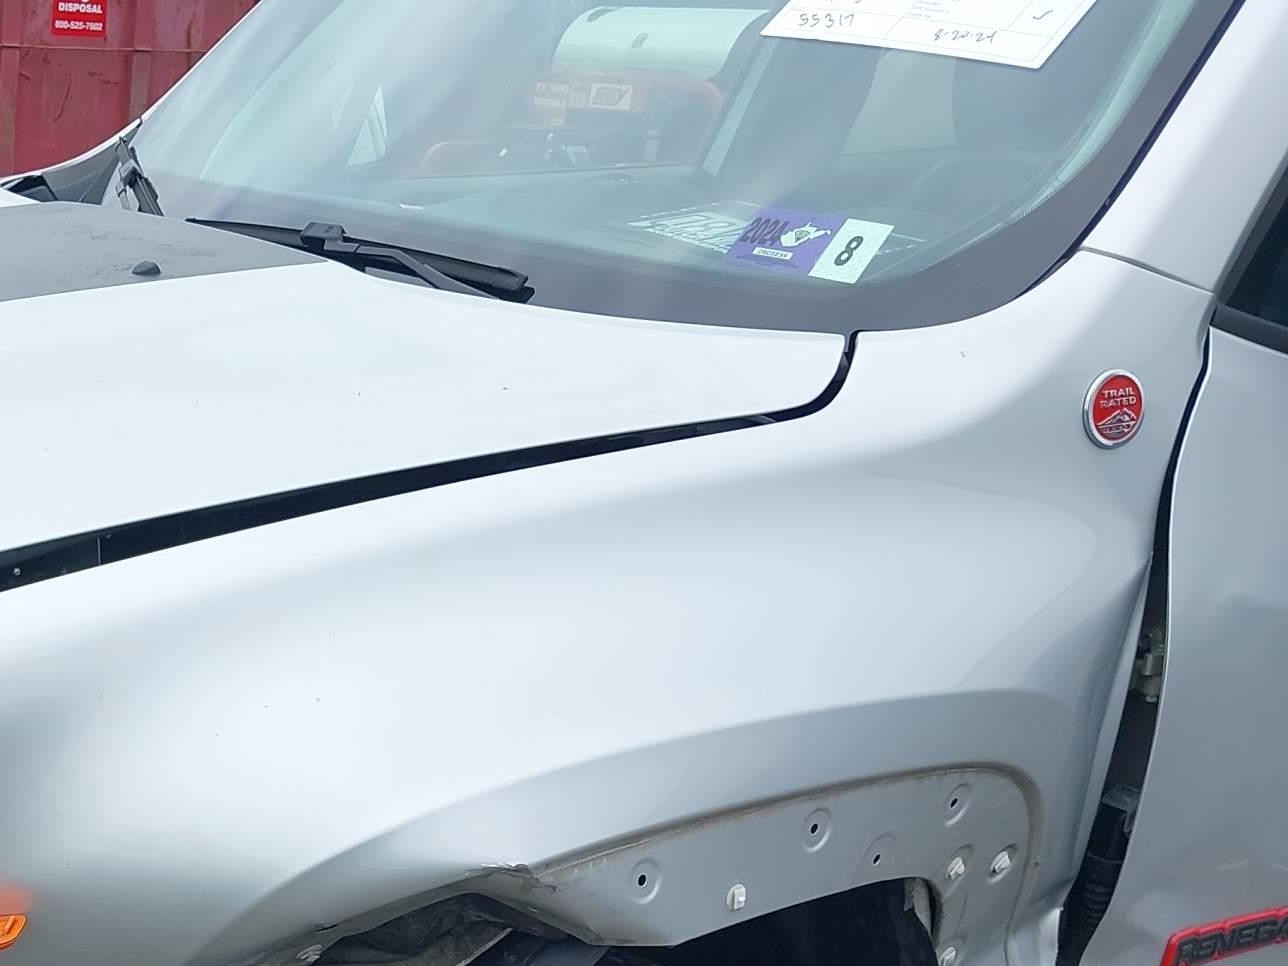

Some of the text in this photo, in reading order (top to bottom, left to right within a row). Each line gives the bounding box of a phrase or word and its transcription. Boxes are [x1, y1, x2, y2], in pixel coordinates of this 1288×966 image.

[58, 2, 103, 14] DISPOSAL
[739, 217, 790, 247] 2024
[833, 235, 864, 266] 8
[1102, 387, 1135, 398] TRAIL
[1099, 397, 1137, 409] RATED
